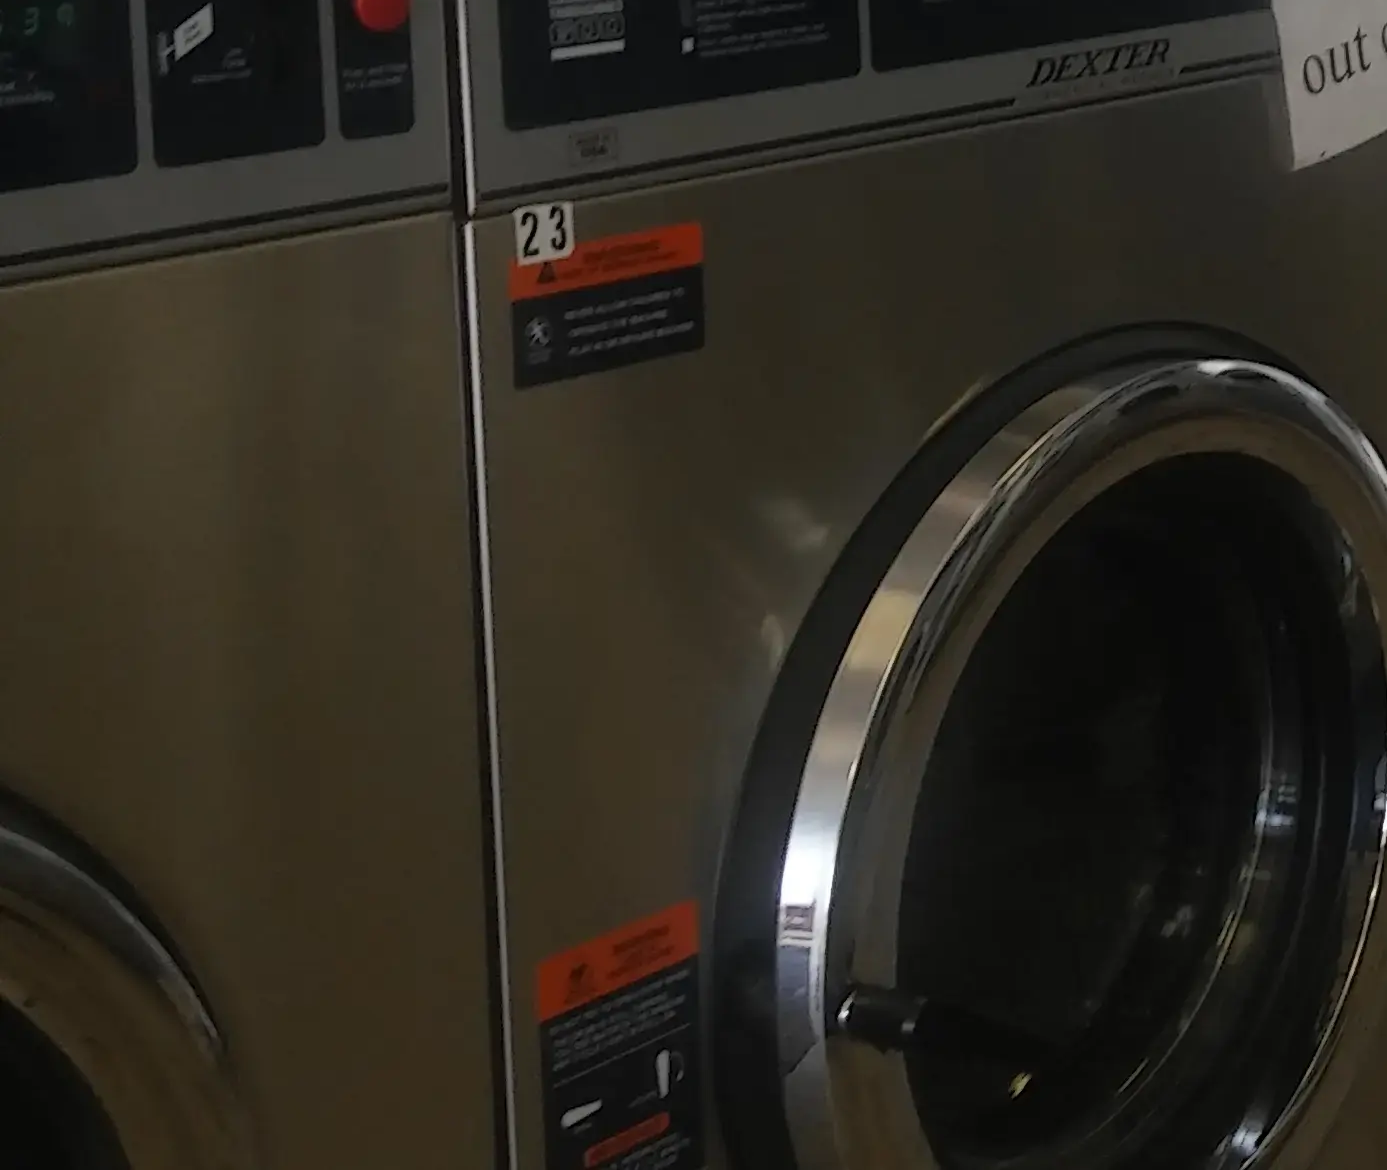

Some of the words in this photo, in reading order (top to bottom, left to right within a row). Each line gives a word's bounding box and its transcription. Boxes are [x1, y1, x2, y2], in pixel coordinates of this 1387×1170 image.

[1026, 38, 1171, 89] DEXTER
[1302, 26, 1372, 95] out
[521, 206, 567, 258] 23
